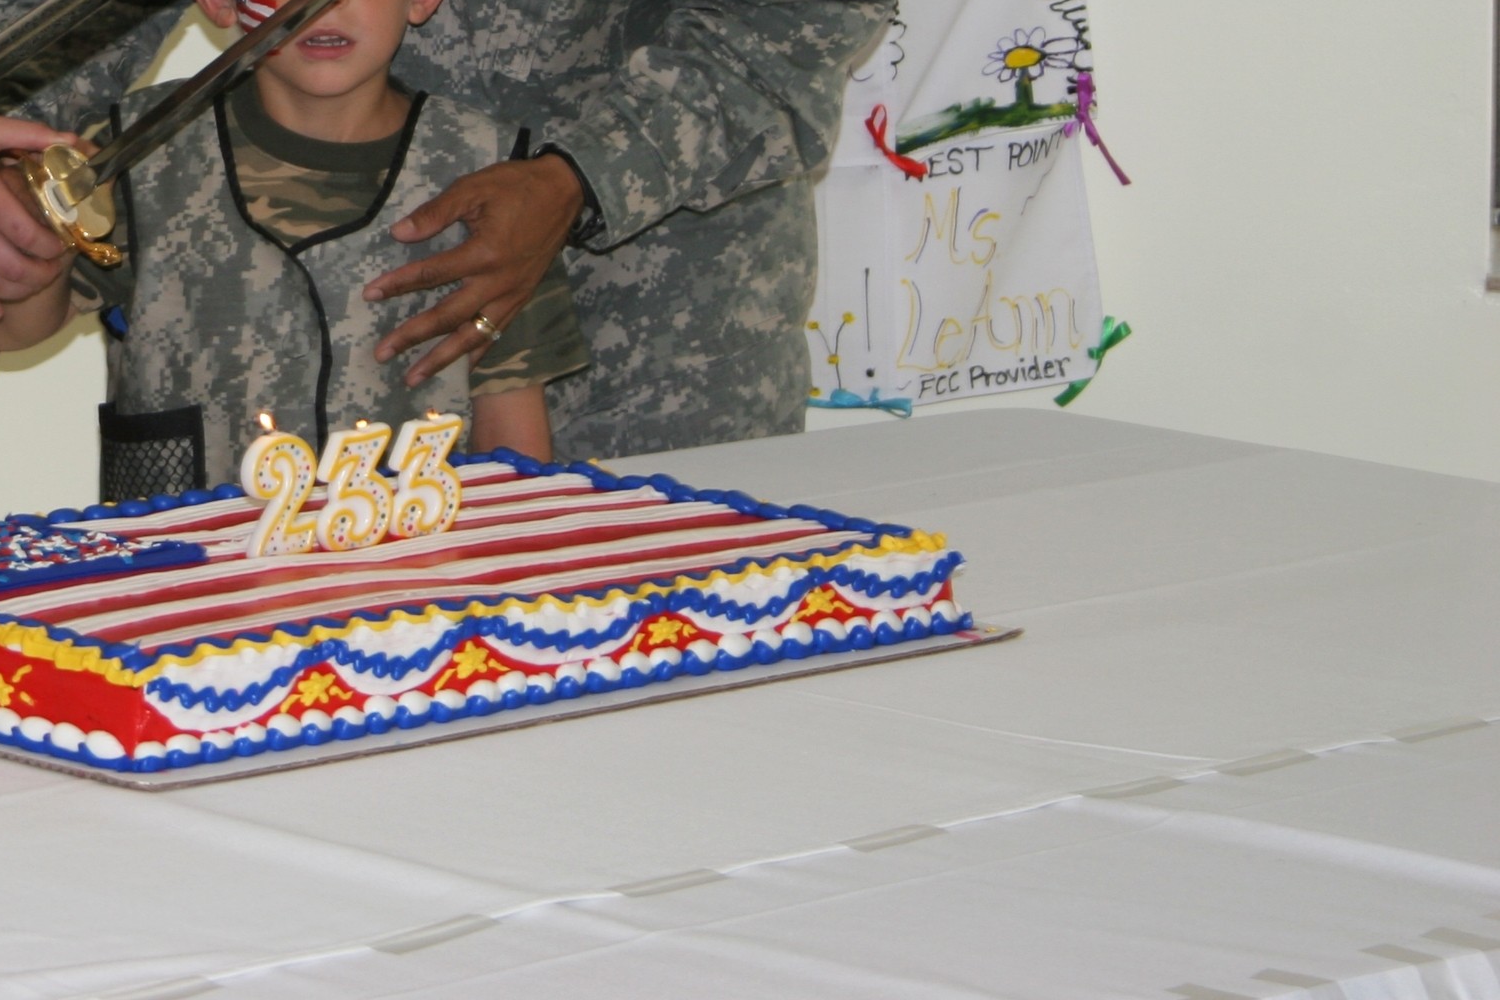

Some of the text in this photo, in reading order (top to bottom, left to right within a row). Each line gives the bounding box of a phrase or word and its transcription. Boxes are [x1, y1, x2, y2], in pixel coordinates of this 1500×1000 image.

[905, 129, 1064, 183] EST POINT
[904, 186, 1000, 269] Ms
[917, 355, 1071, 398] FCC Provider
[241, 414, 463, 556] 233
